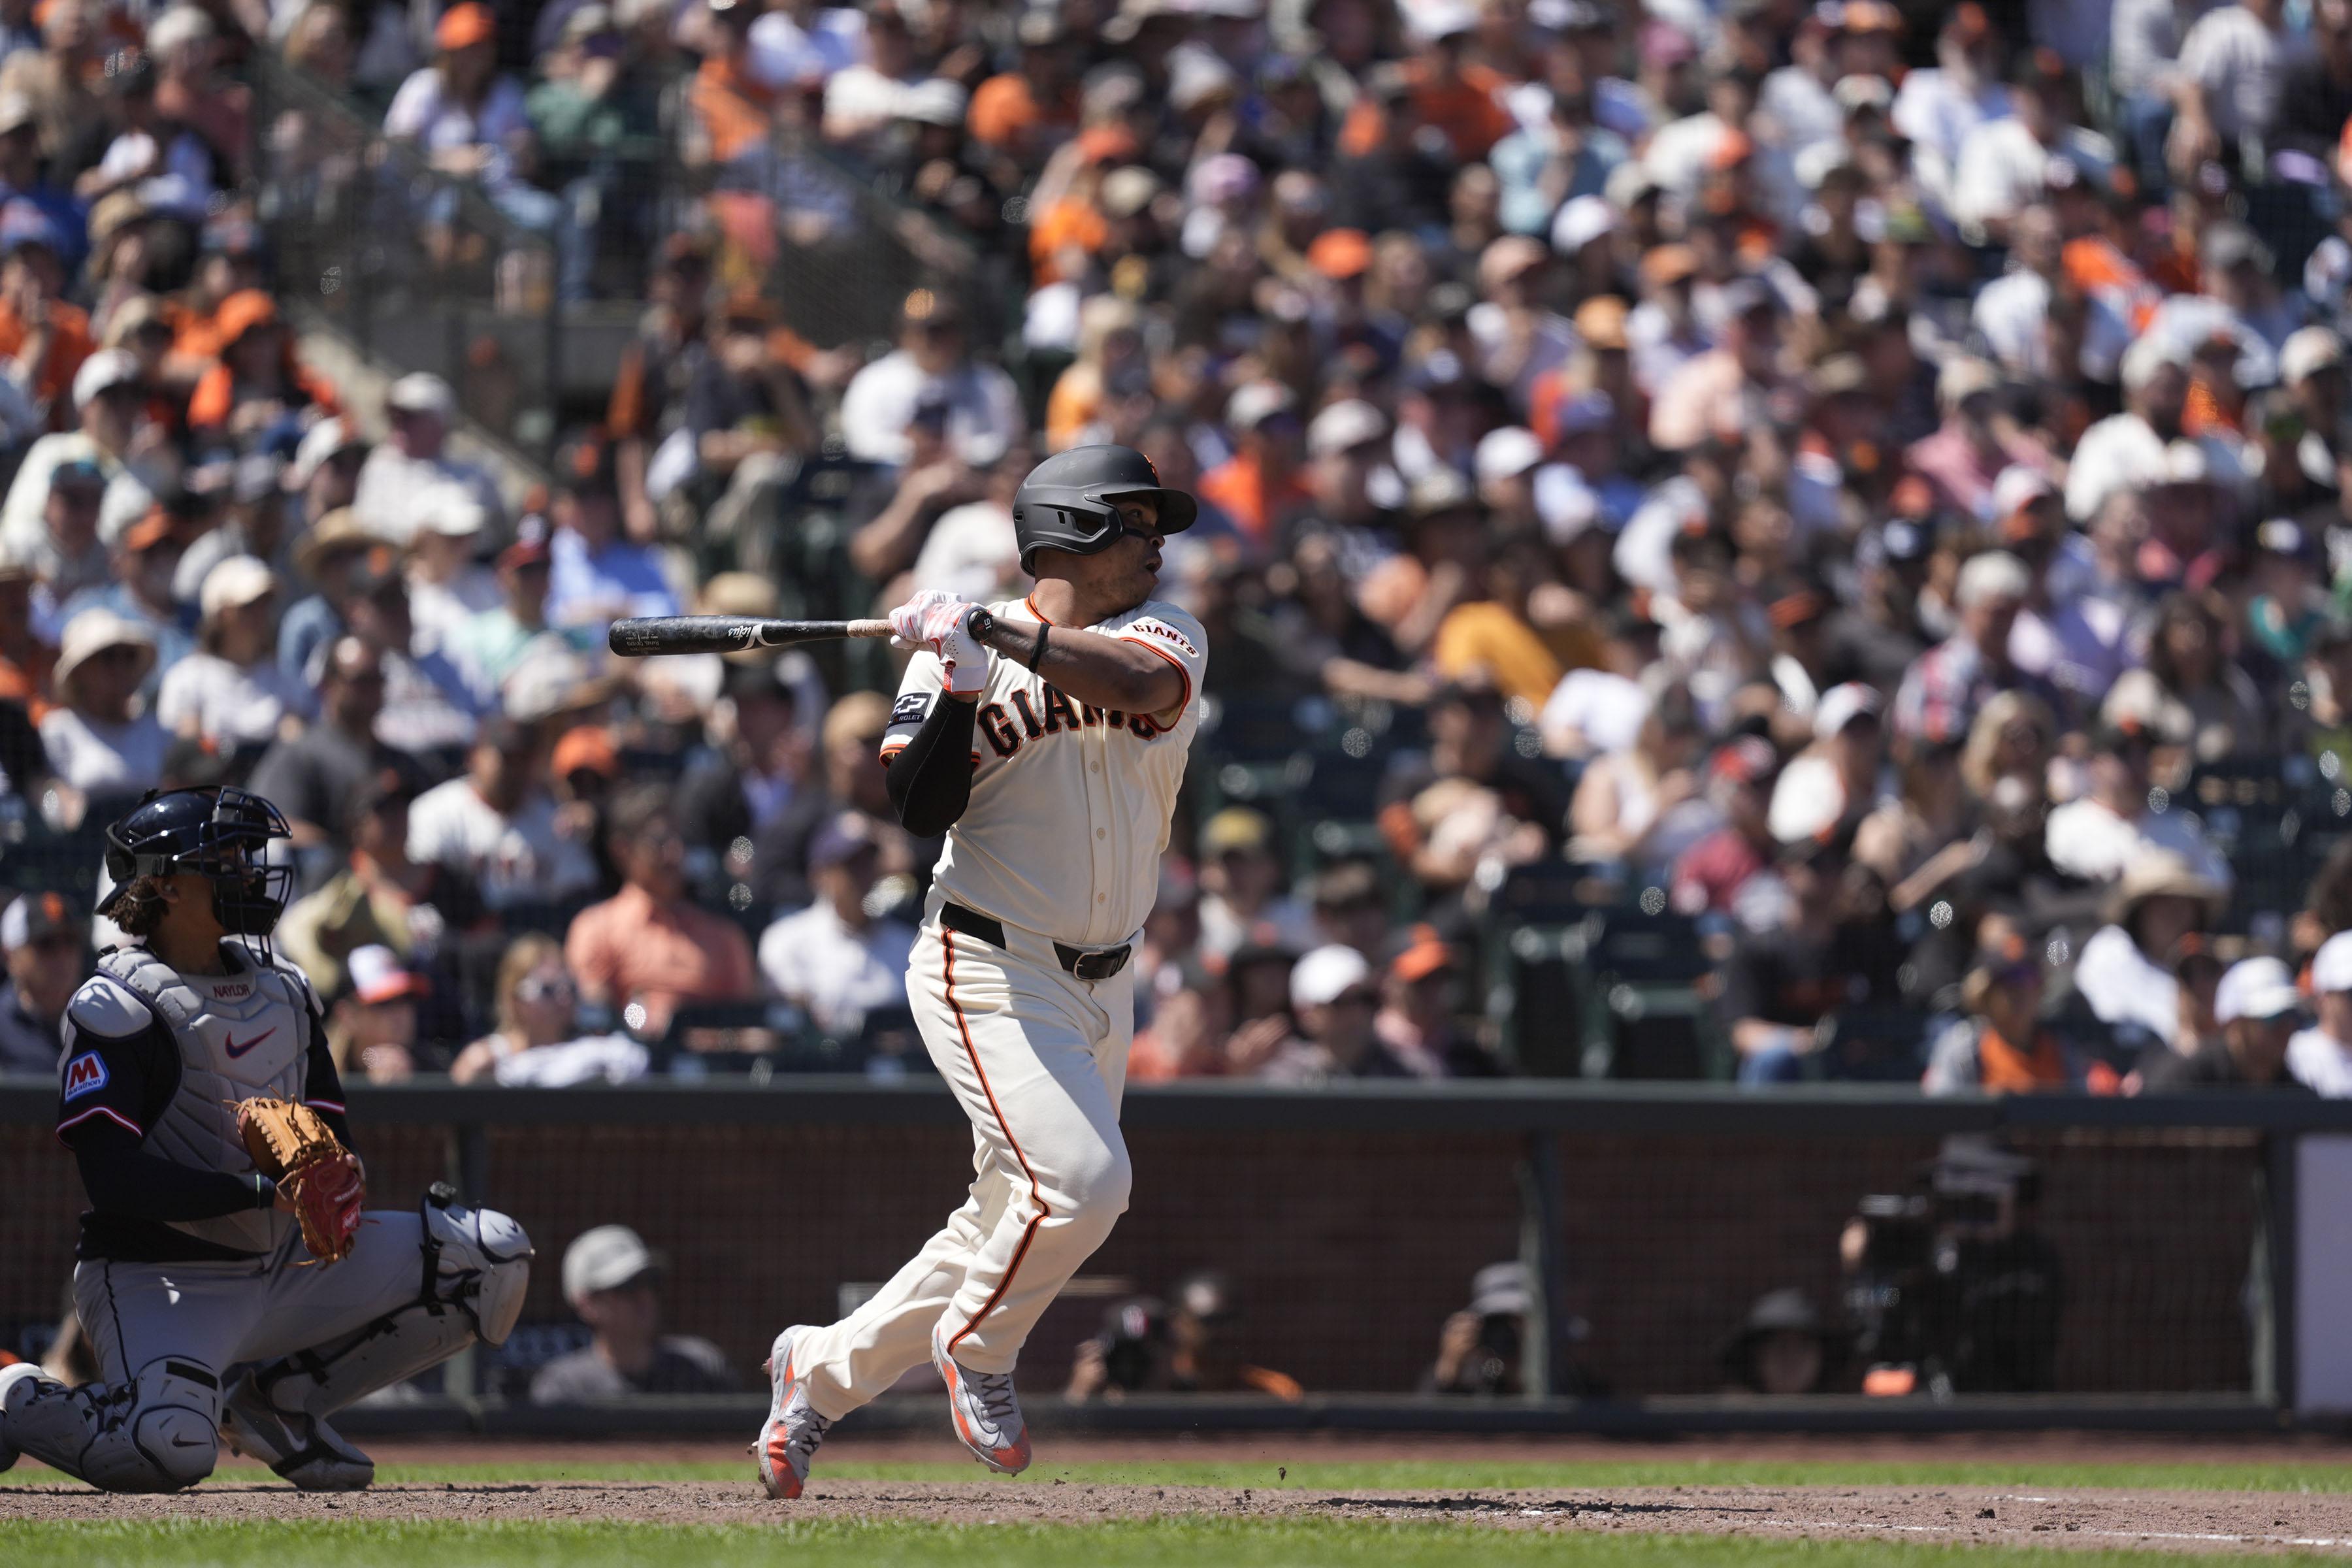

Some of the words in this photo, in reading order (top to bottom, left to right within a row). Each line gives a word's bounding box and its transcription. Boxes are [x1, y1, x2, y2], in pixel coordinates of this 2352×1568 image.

[728, 623, 783, 649] Victus
[984, 617, 992, 630] 16
[1132, 625, 1197, 655] GIANTS
[977, 681, 1158, 759] GIA
[213, 983, 251, 998] NAYLOR
[69, 1056, 100, 1090] M
[67, 1079, 101, 1098] Marathon
